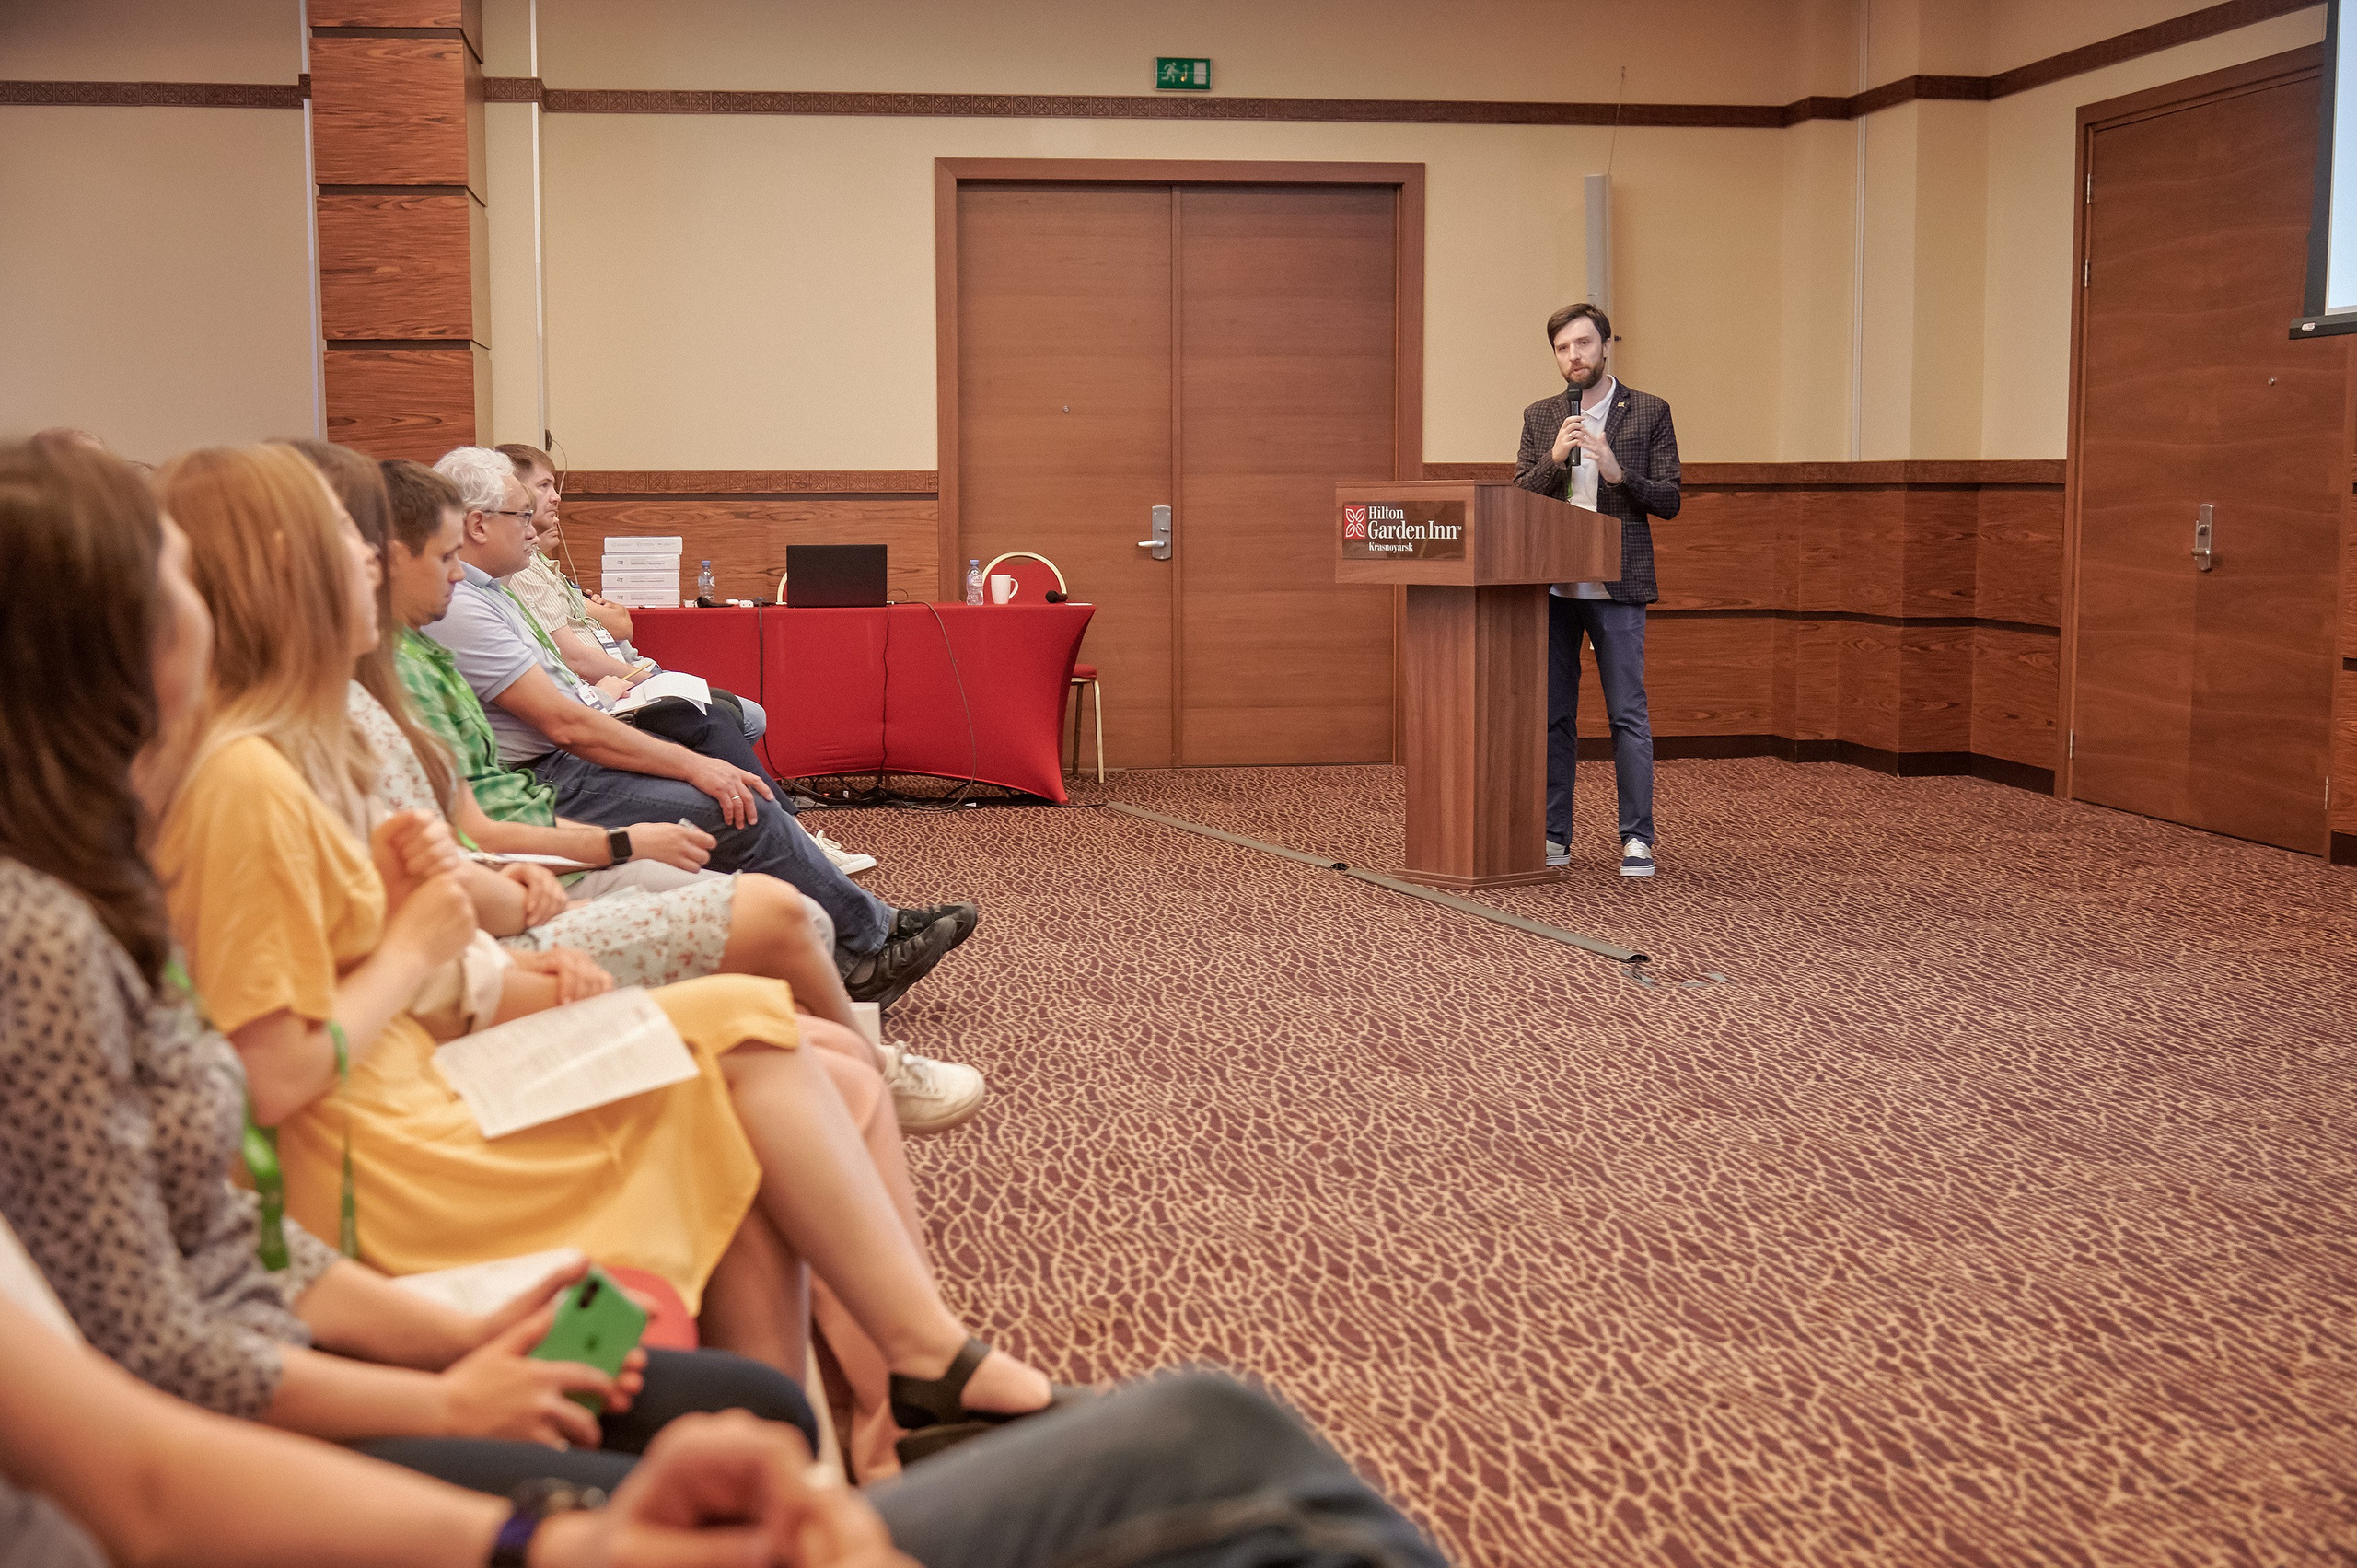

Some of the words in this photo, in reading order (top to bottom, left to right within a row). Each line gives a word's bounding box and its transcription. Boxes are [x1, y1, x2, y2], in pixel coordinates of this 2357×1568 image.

[1368, 506, 1404, 520] Hilton
[1367, 520, 1426, 540] Garden
[1368, 541, 1413, 553] Krasnoyarsk
